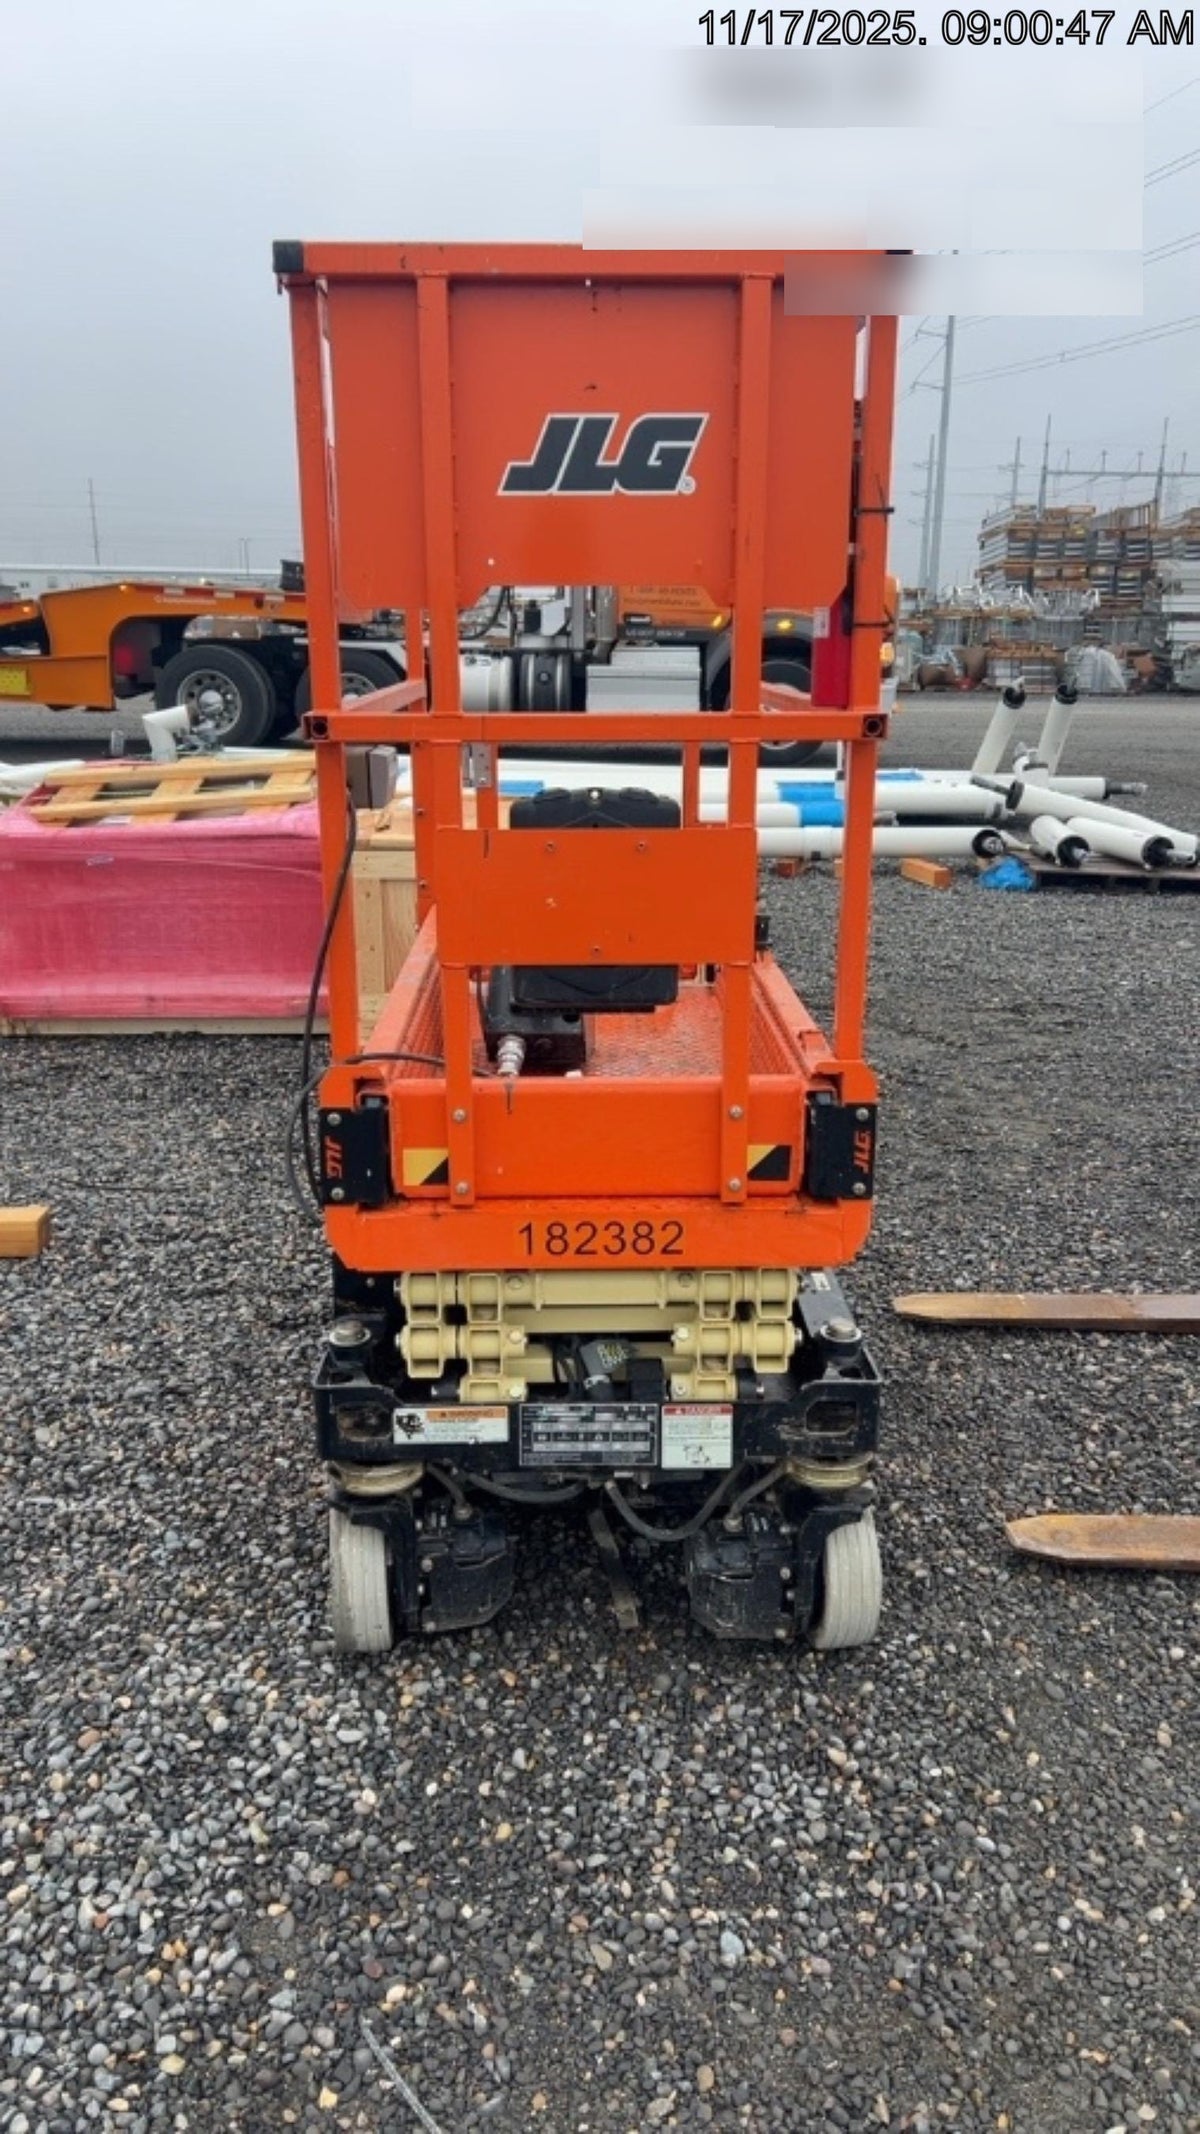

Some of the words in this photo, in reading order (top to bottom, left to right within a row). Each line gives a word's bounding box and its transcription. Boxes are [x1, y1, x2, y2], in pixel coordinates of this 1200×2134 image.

[498, 412, 709, 495] JLG
[324, 1135, 343, 1179] JLG
[853, 1129, 871, 1174] JLG
[518, 1220, 684, 1256] 182382
